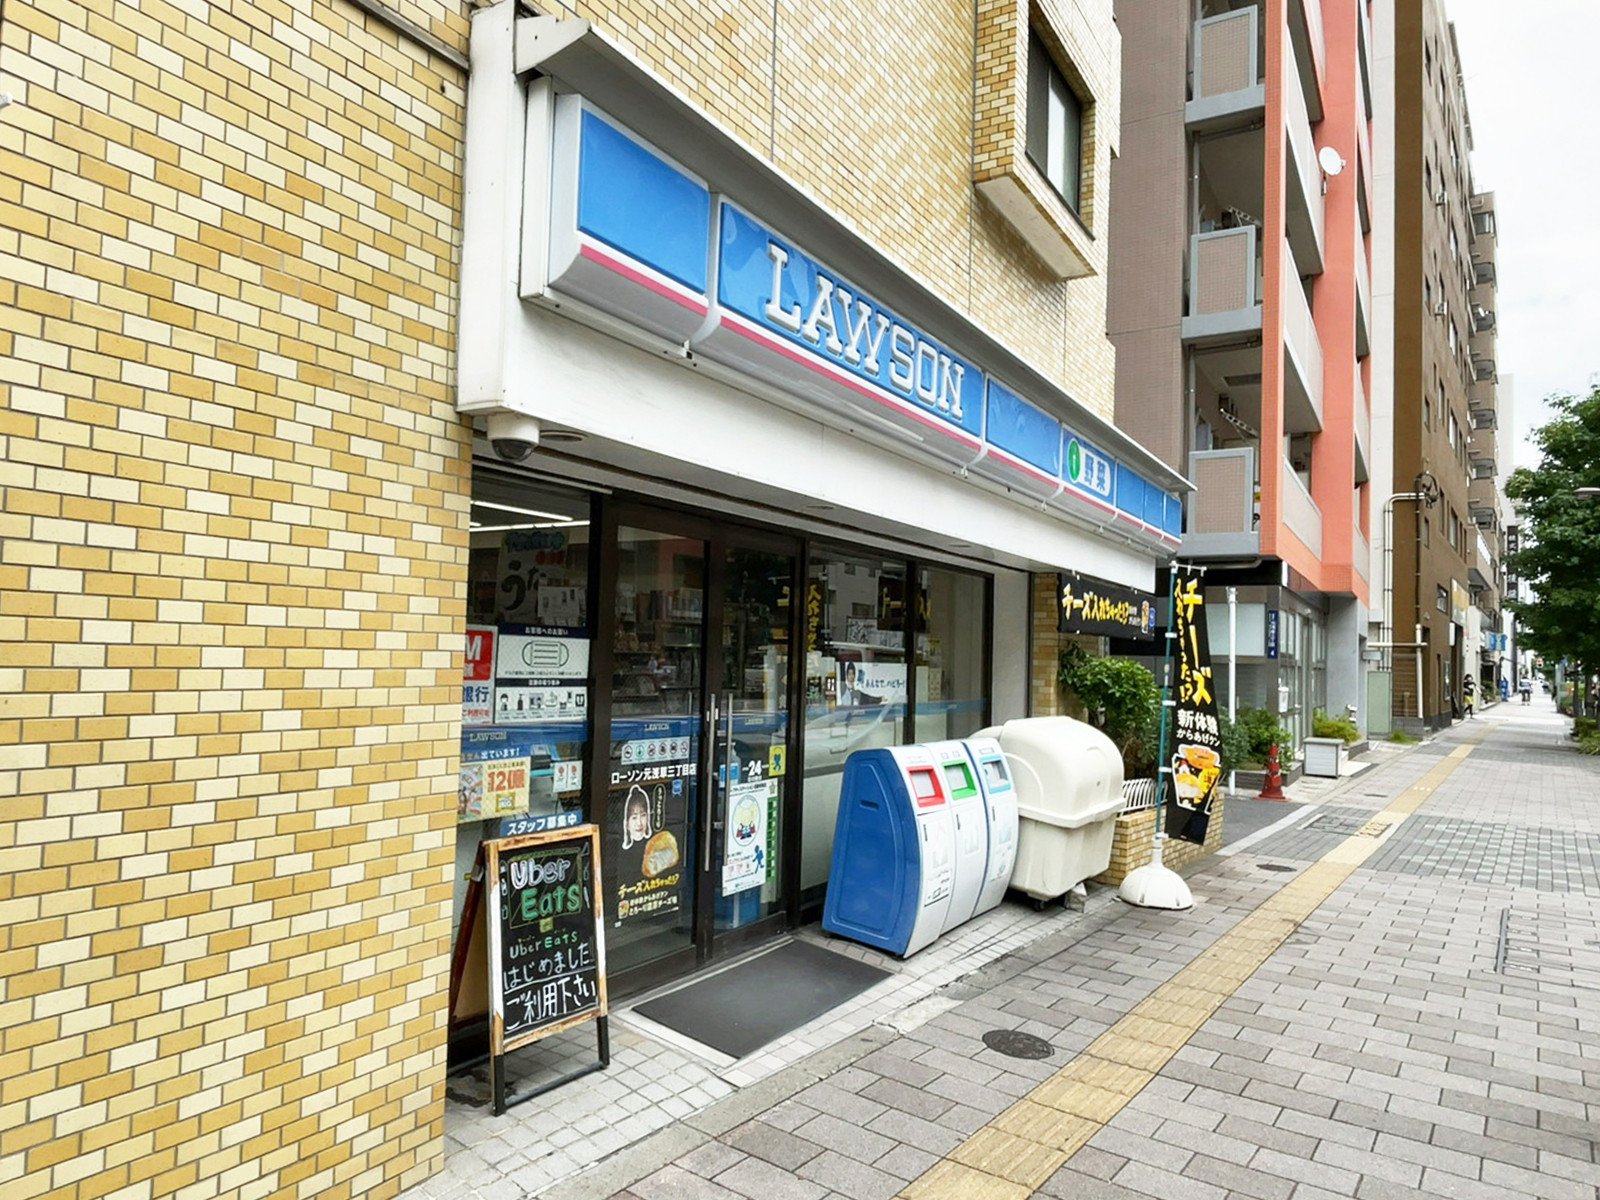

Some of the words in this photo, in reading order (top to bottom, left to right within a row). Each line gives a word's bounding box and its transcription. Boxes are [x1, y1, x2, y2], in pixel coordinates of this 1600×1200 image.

[765, 243, 965, 420] LAWSON
[1183, 578, 1213, 706] チーズ
[1177, 708, 1219, 737] 新体験
[506, 813, 577, 836] スタッフ募集中
[511, 857, 571, 890] Uber
[521, 883, 581, 921] Eats
[503, 942, 591, 991] はじめました
[505, 974, 597, 1031] ご利用下さい
